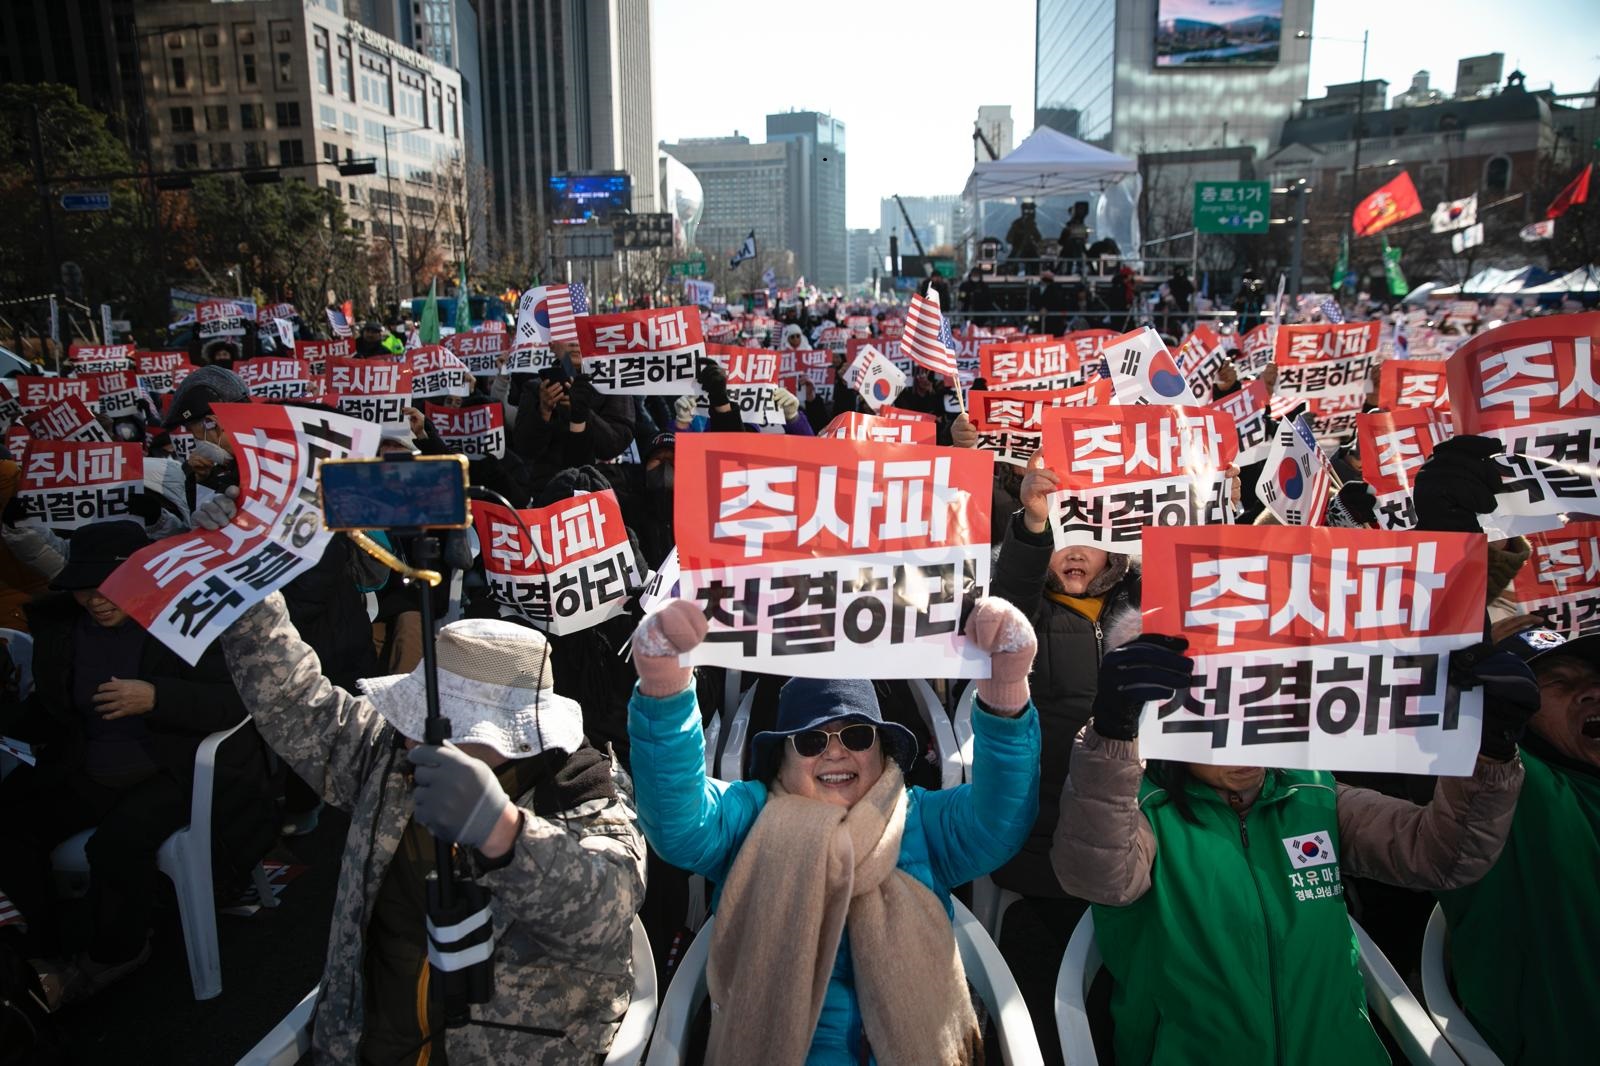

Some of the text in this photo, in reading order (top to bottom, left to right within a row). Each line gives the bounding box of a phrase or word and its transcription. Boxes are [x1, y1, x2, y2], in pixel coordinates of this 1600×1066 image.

[1201, 186, 1262, 203] 종로1가
[201, 303, 239, 319] 주사파
[460, 335, 501, 355] 주사파
[595, 310, 688, 353] 주사파
[1289, 325, 1371, 363] 주사파
[77, 345, 129, 361] 주사파
[141, 352, 184, 373] 주사파
[303, 341, 350, 361] 주사파
[590, 349, 701, 390] 척결하라
[992, 344, 1069, 382] 주사파
[27, 380, 90, 405] 주사파
[252, 382, 308, 399] 결하라
[332, 364, 401, 394] 주사파
[412, 371, 466, 394] 척결하라
[1279, 356, 1373, 393] 척결하라
[340, 396, 405, 423] 결하라
[432, 406, 494, 435] 주사파
[26, 446, 127, 487] 주사파
[1071, 415, 1223, 484] 주사파
[143, 427, 299, 589] 주사파
[713, 456, 960, 558] 주사파
[1060, 479, 1230, 542] 척결하라
[491, 497, 606, 571] 주사파
[696, 558, 983, 658] 척결하라
[1184, 541, 1446, 647] 주사파
[1157, 653, 1472, 749] 척결하라
